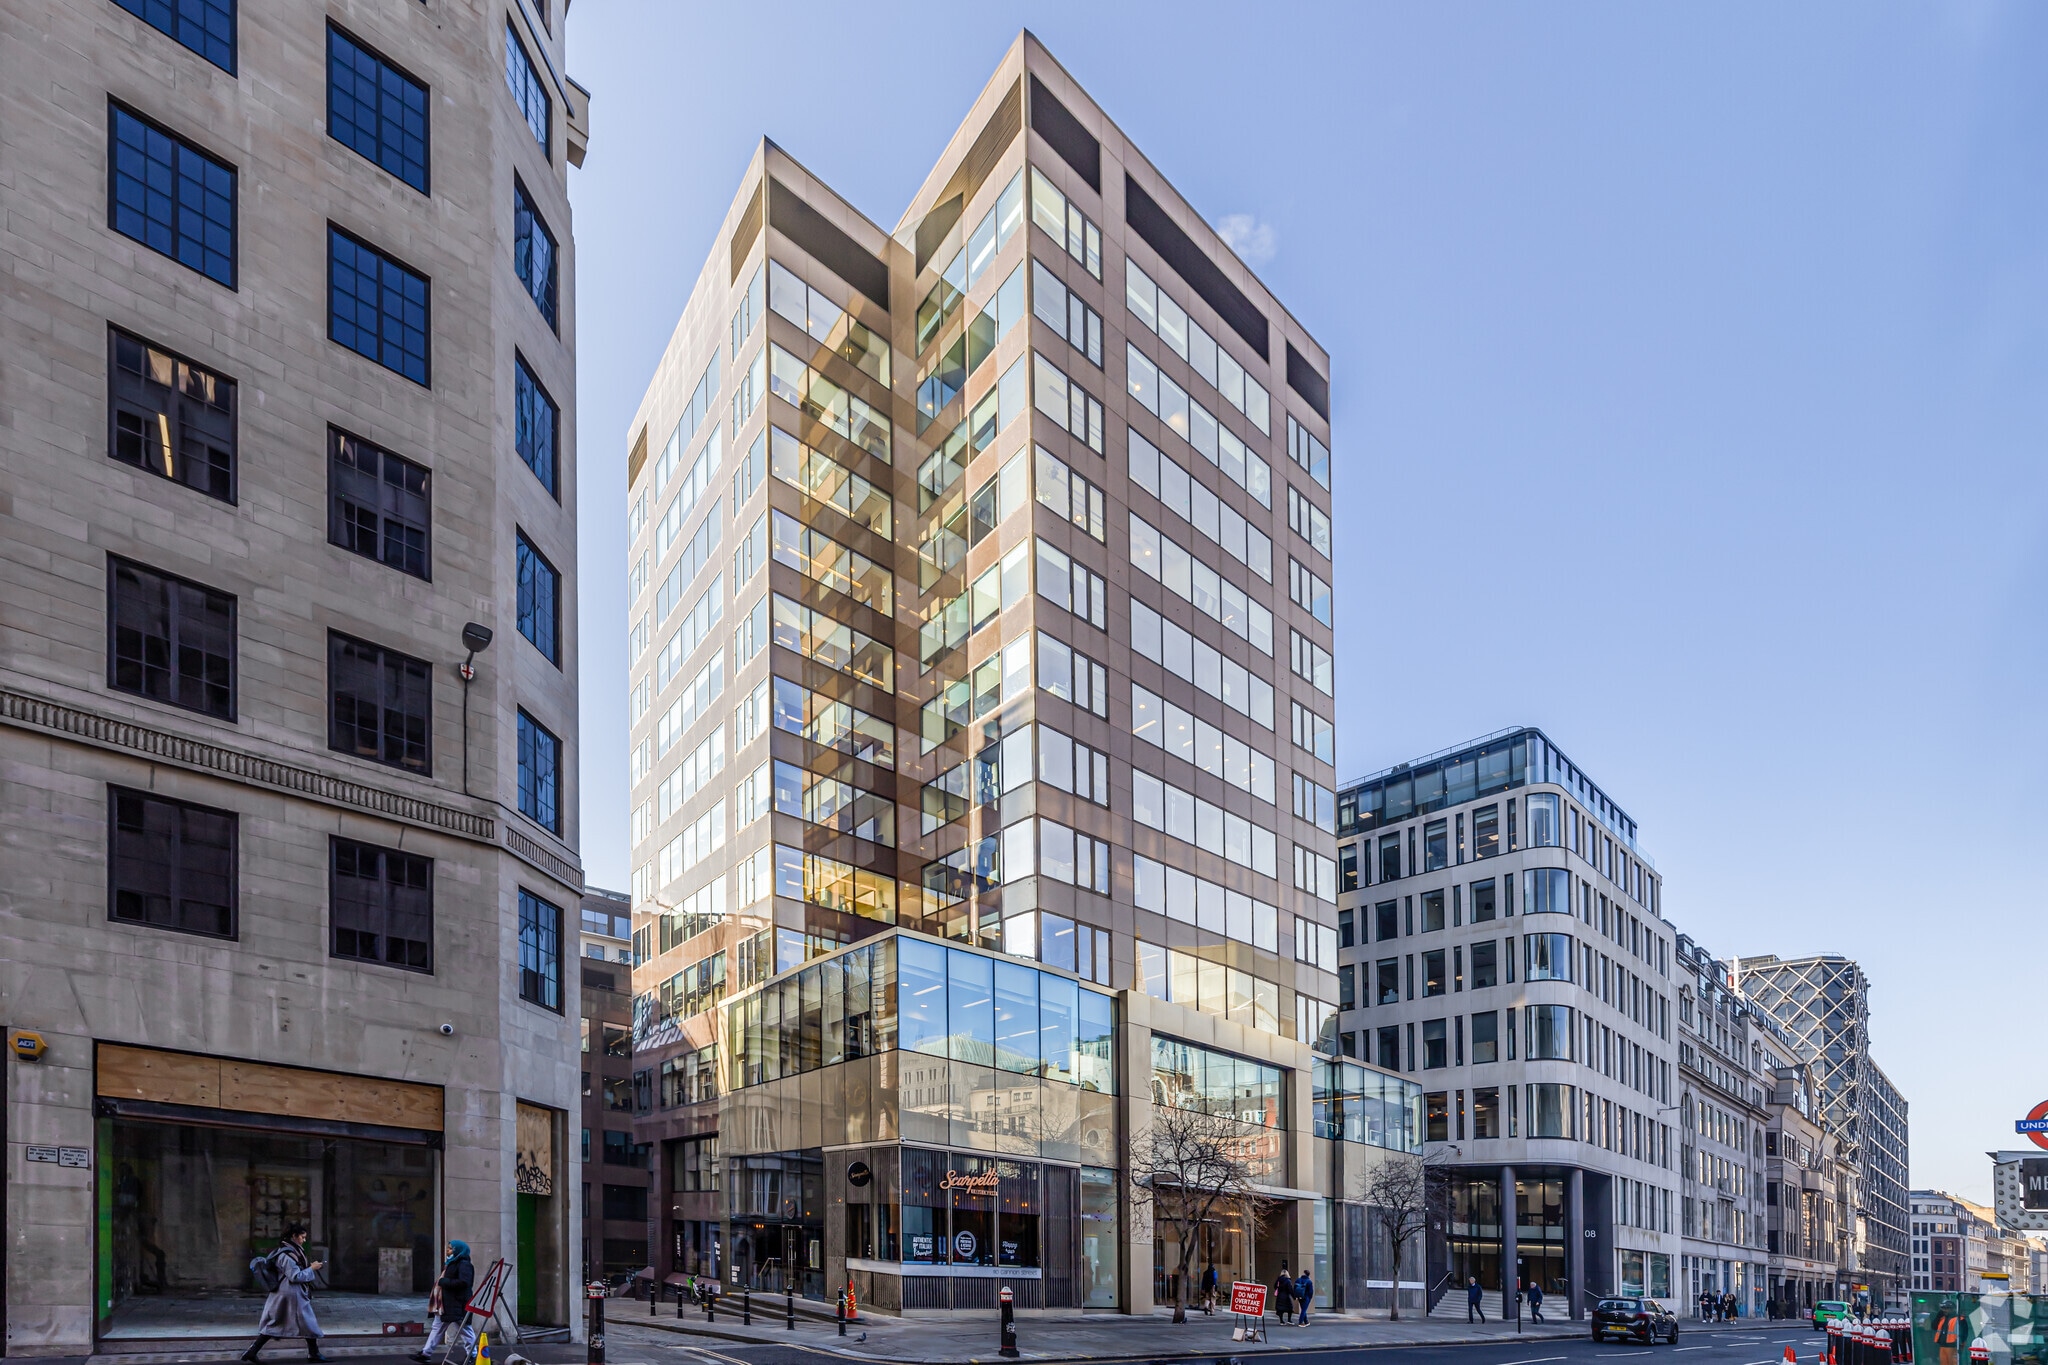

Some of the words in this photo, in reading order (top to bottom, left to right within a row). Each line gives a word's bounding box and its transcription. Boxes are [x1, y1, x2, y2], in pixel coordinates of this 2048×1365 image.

[18, 1040, 35, 1048] ADT
[939, 1167, 1000, 1194] Scarpetta
[1584, 1229, 1596, 1238] 08
[1247, 1292, 1258, 1300] NOT
[1235, 1298, 1260, 1306] OVERTAKE
[1235, 1304, 1258, 1313] CYCLISTS
